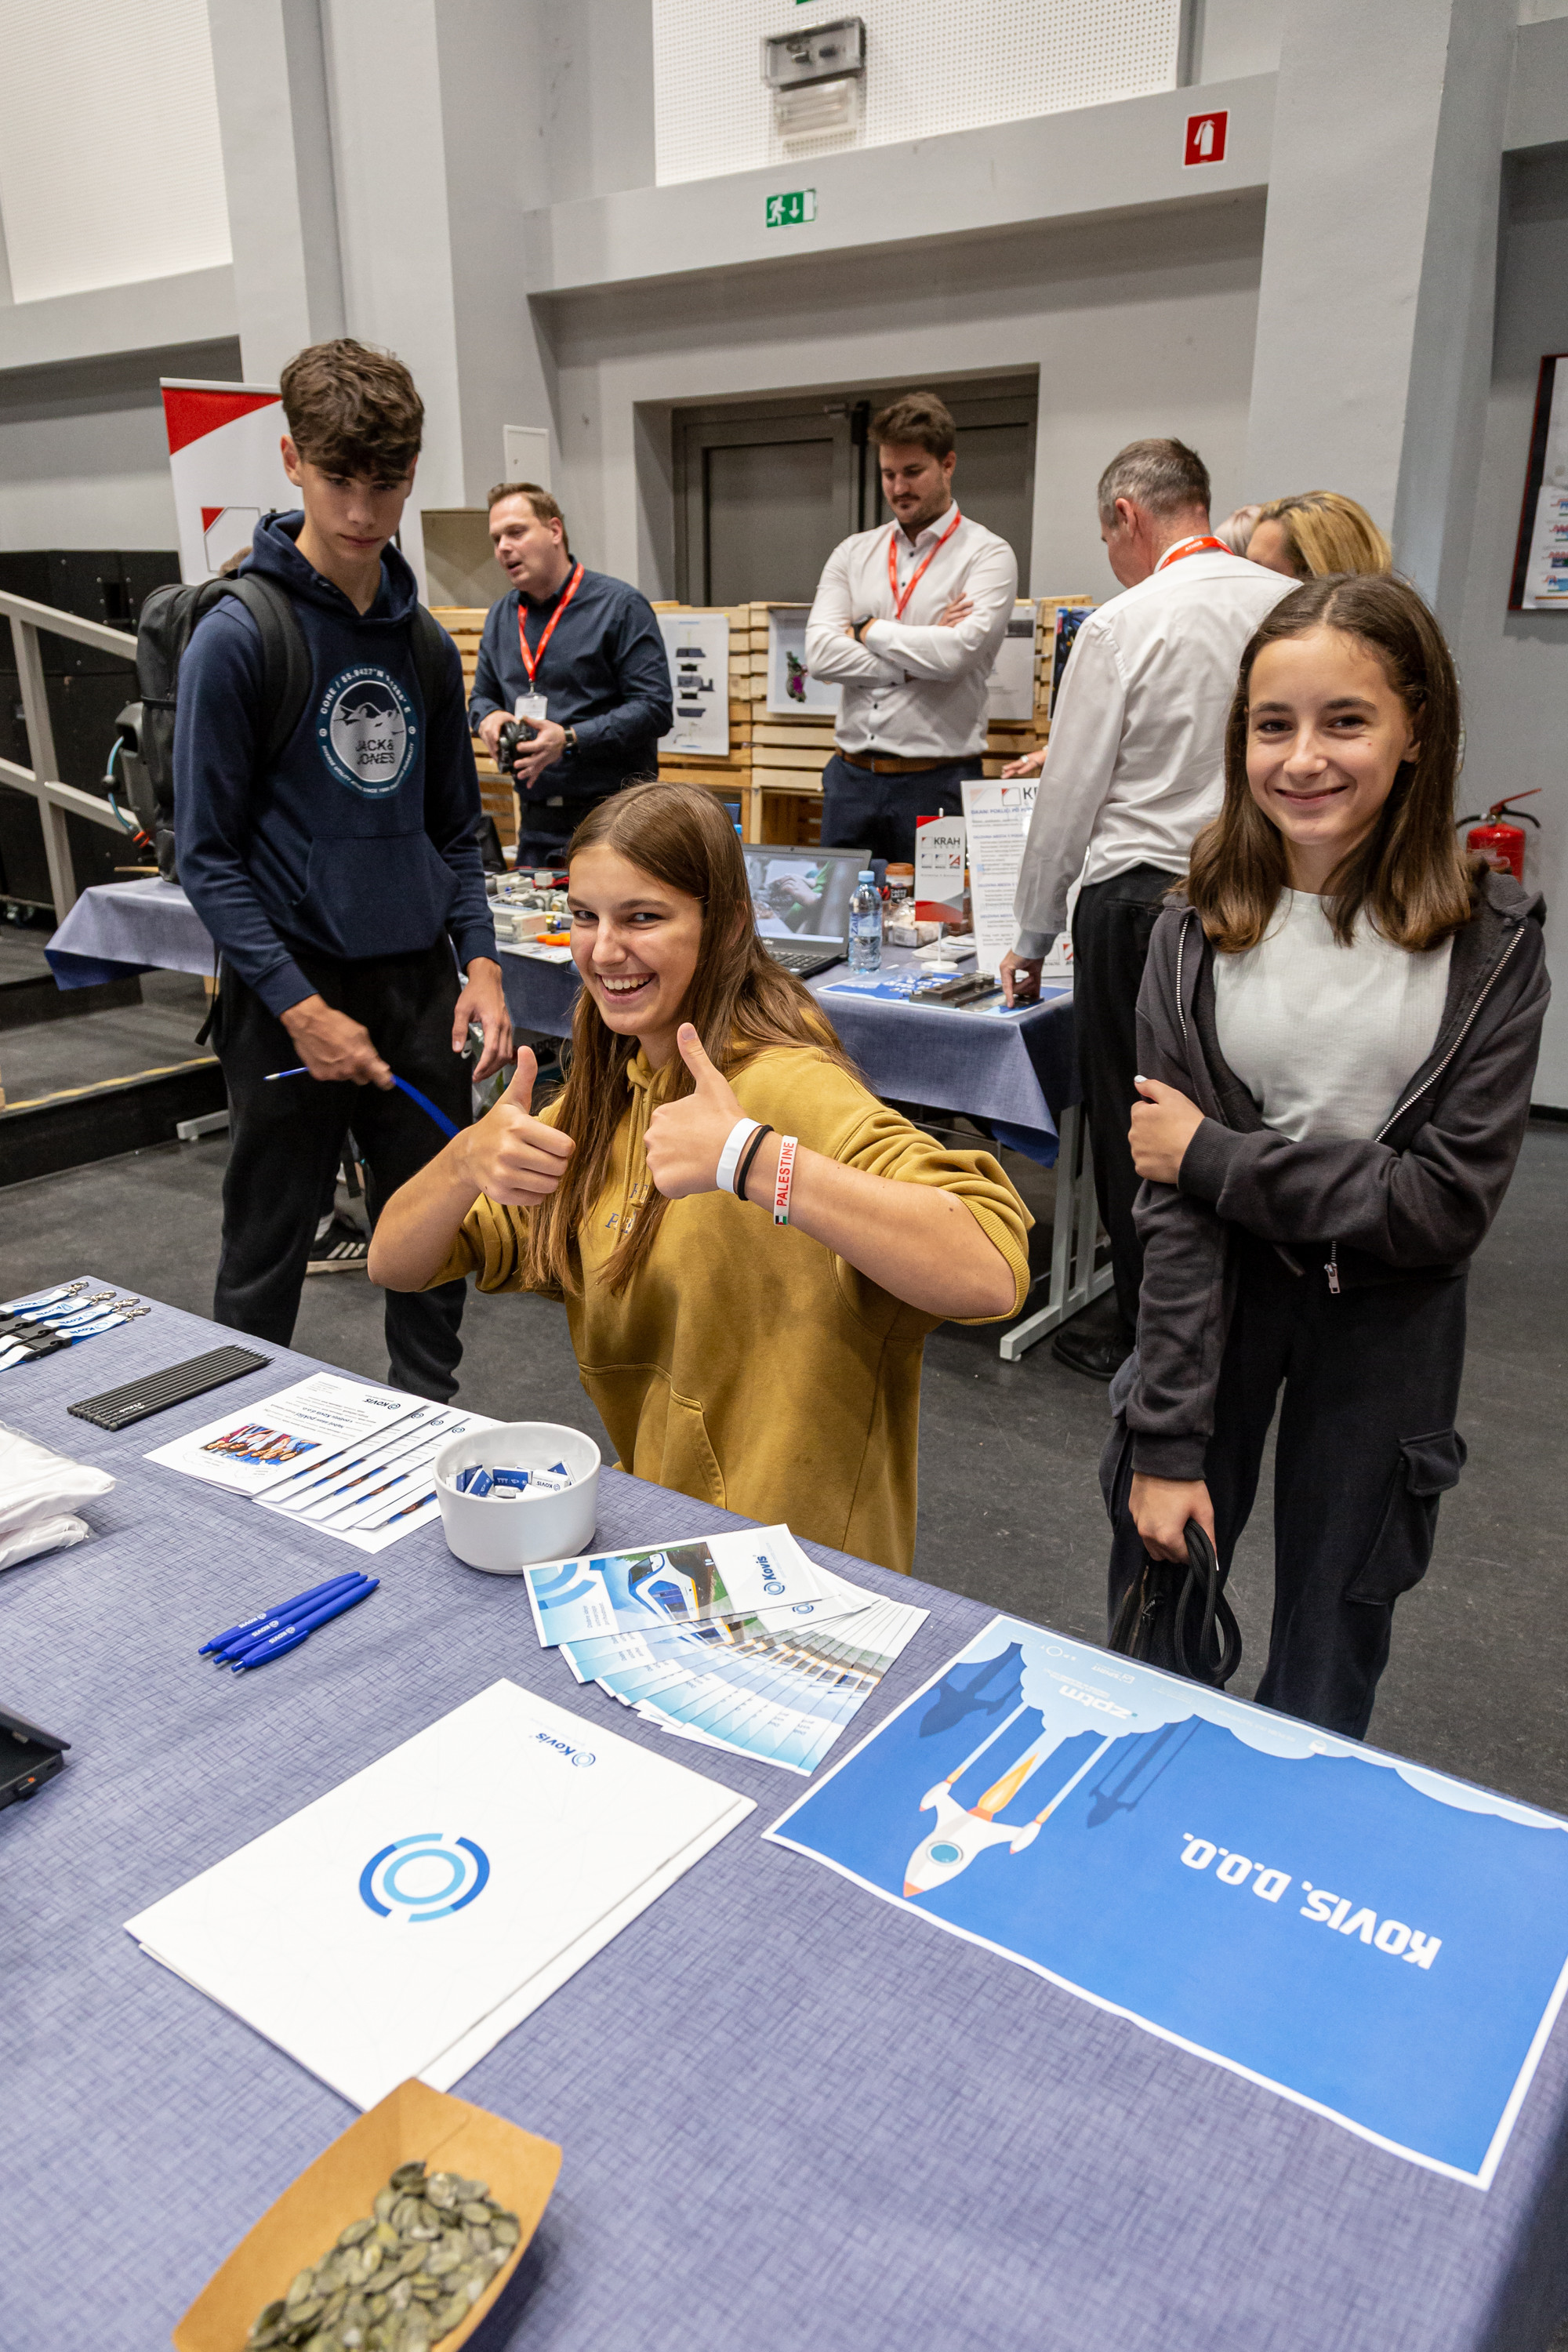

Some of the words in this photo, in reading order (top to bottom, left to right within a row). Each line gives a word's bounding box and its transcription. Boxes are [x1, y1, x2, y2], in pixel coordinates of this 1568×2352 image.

[320, 688, 337, 714] CORE
[357, 753, 395, 765] JONES
[934, 837, 960, 845] KRAH
[776, 1142, 794, 1207] PALESTINE
[365, 1398, 389, 1408] KOVIS
[238, 1617, 259, 1628] KOVIS
[251, 1624, 270, 1637] KOVIS
[268, 1631, 288, 1644] KOVIS
[1058, 1684, 1133, 1719] zptm
[535, 1733, 577, 1756] Kovis
[1180, 1831, 1293, 1904] D.O.O.
